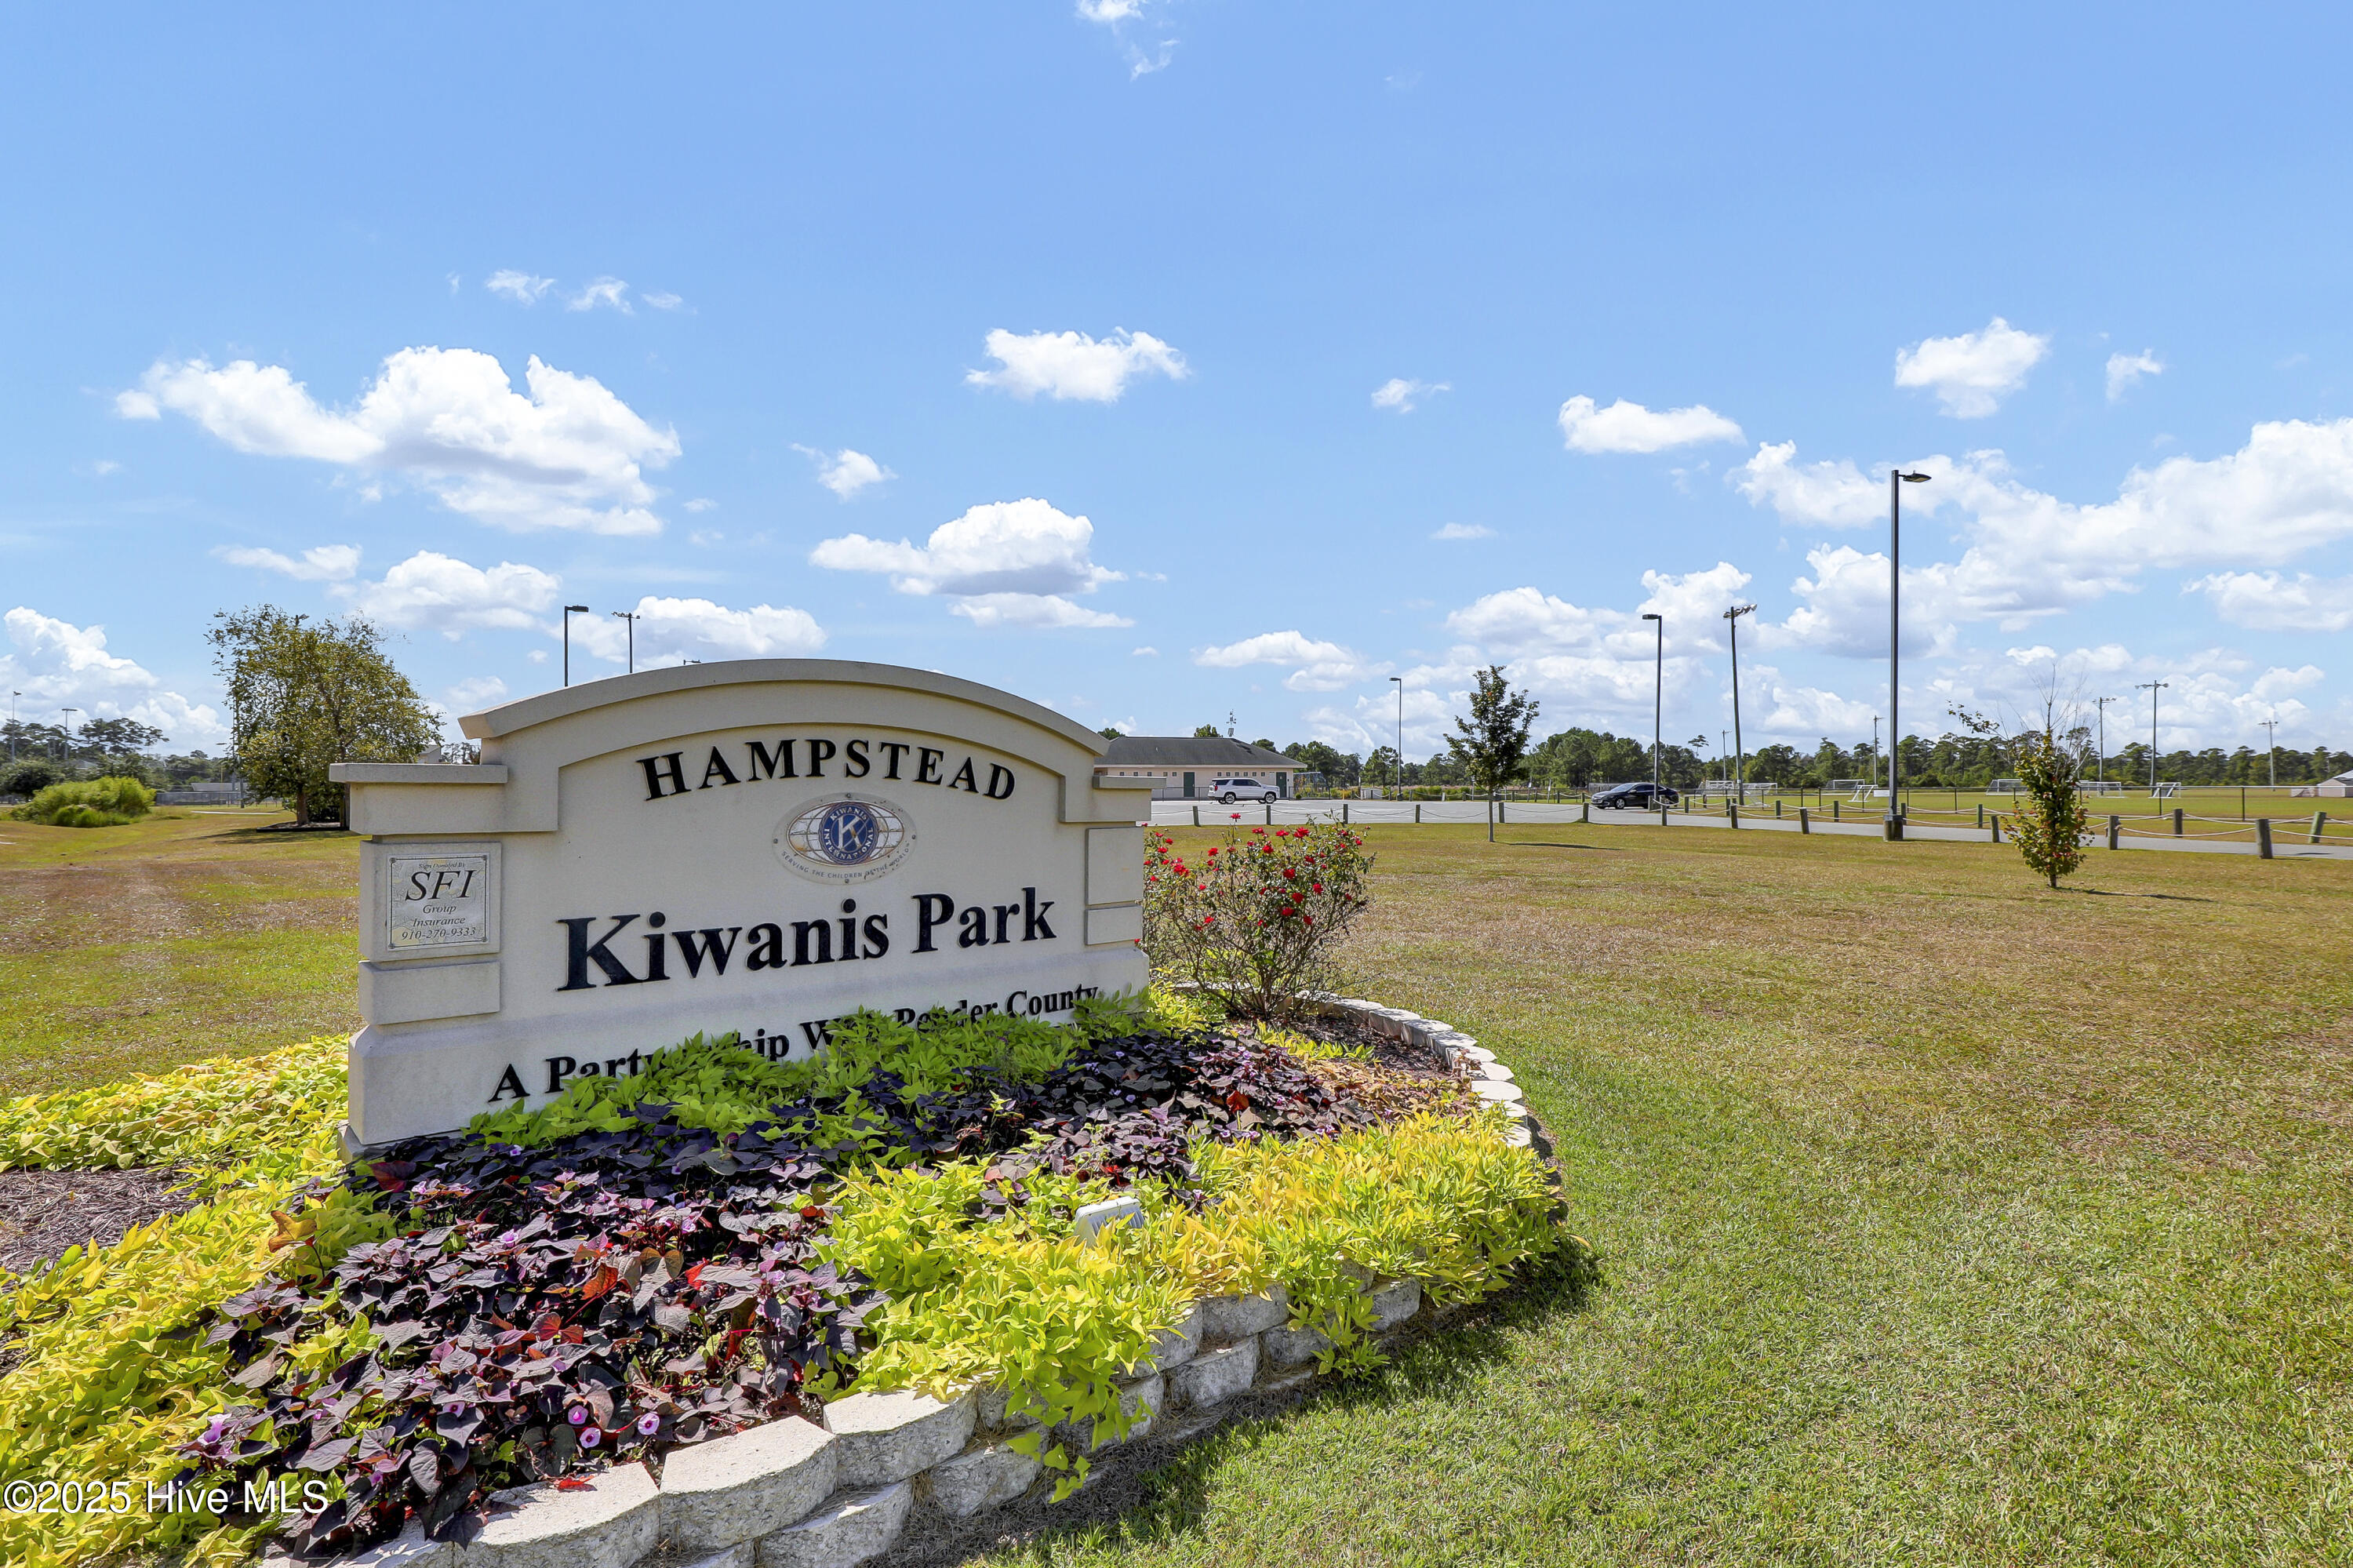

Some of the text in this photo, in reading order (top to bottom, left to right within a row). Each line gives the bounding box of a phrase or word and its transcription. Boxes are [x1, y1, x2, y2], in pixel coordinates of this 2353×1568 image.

[636, 739, 1016, 801] HAMPSTEAD
[830, 806, 867, 821] KIWANIS
[824, 828, 875, 860] INTERNATIONAL
[781, 851, 809, 873] SERVING
[812, 869, 825, 878] THE
[405, 870, 477, 901] SFI
[413, 917, 466, 927] Insurance
[423, 904, 456, 914] Group
[402, 926, 477, 940] 910-270-9333
[555, 886, 1056, 991] Kiwanis Park
[487, 1062, 531, 1103] A
